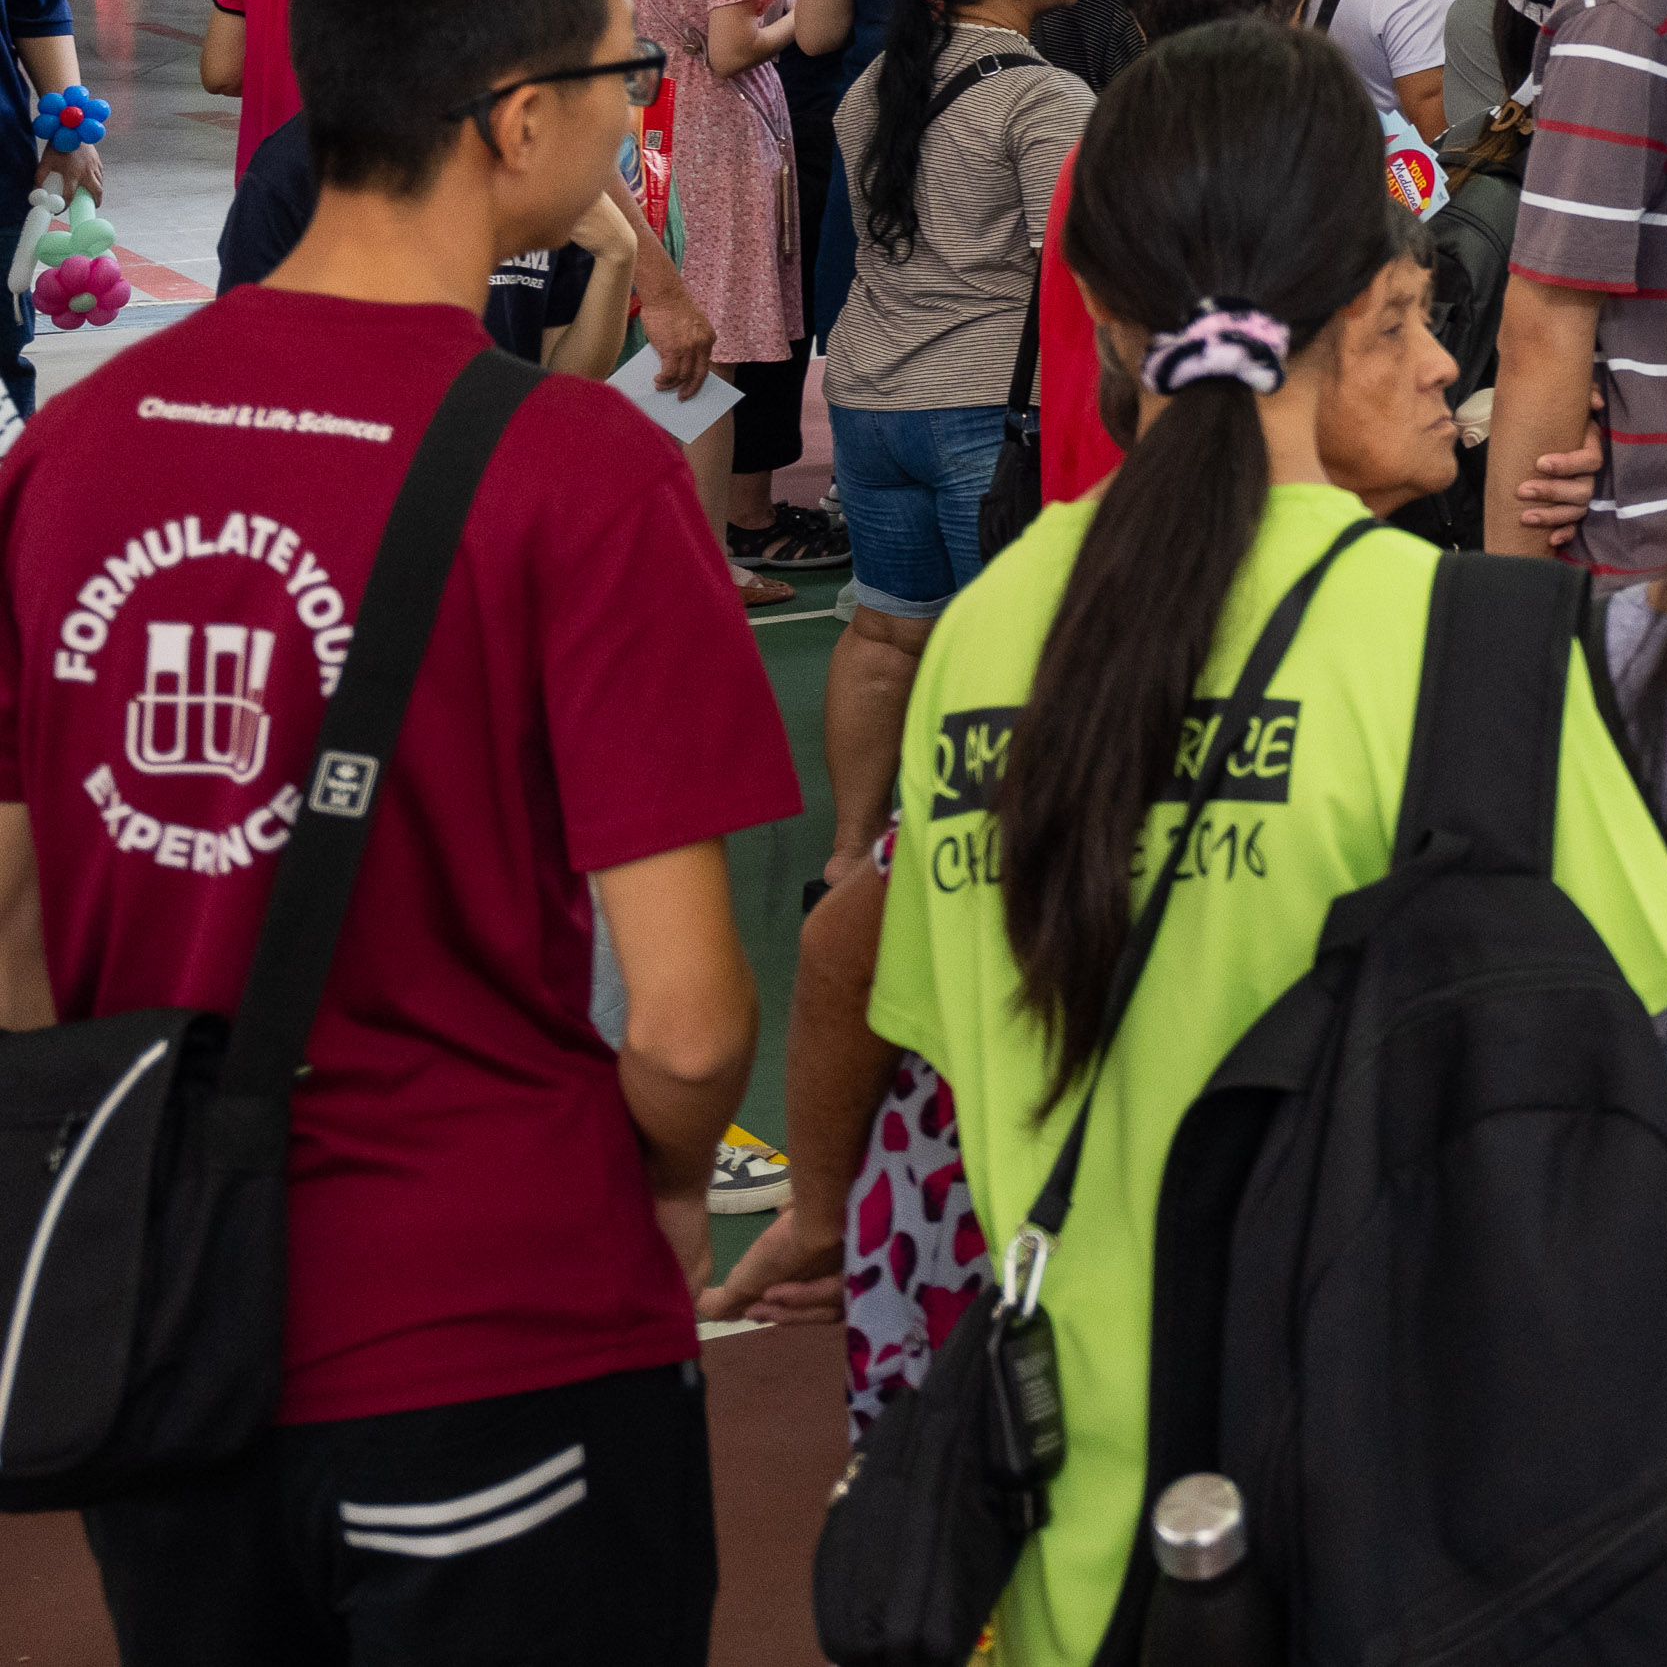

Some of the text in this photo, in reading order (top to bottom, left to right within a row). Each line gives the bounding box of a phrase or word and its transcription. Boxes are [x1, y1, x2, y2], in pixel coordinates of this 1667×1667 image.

[1391, 162, 1420, 209] Medicine
[1408, 159, 1427, 191] YOUR
[138, 396, 393, 444] Chemical & Life Sciences
[54, 512, 301, 684] FORMULATE
